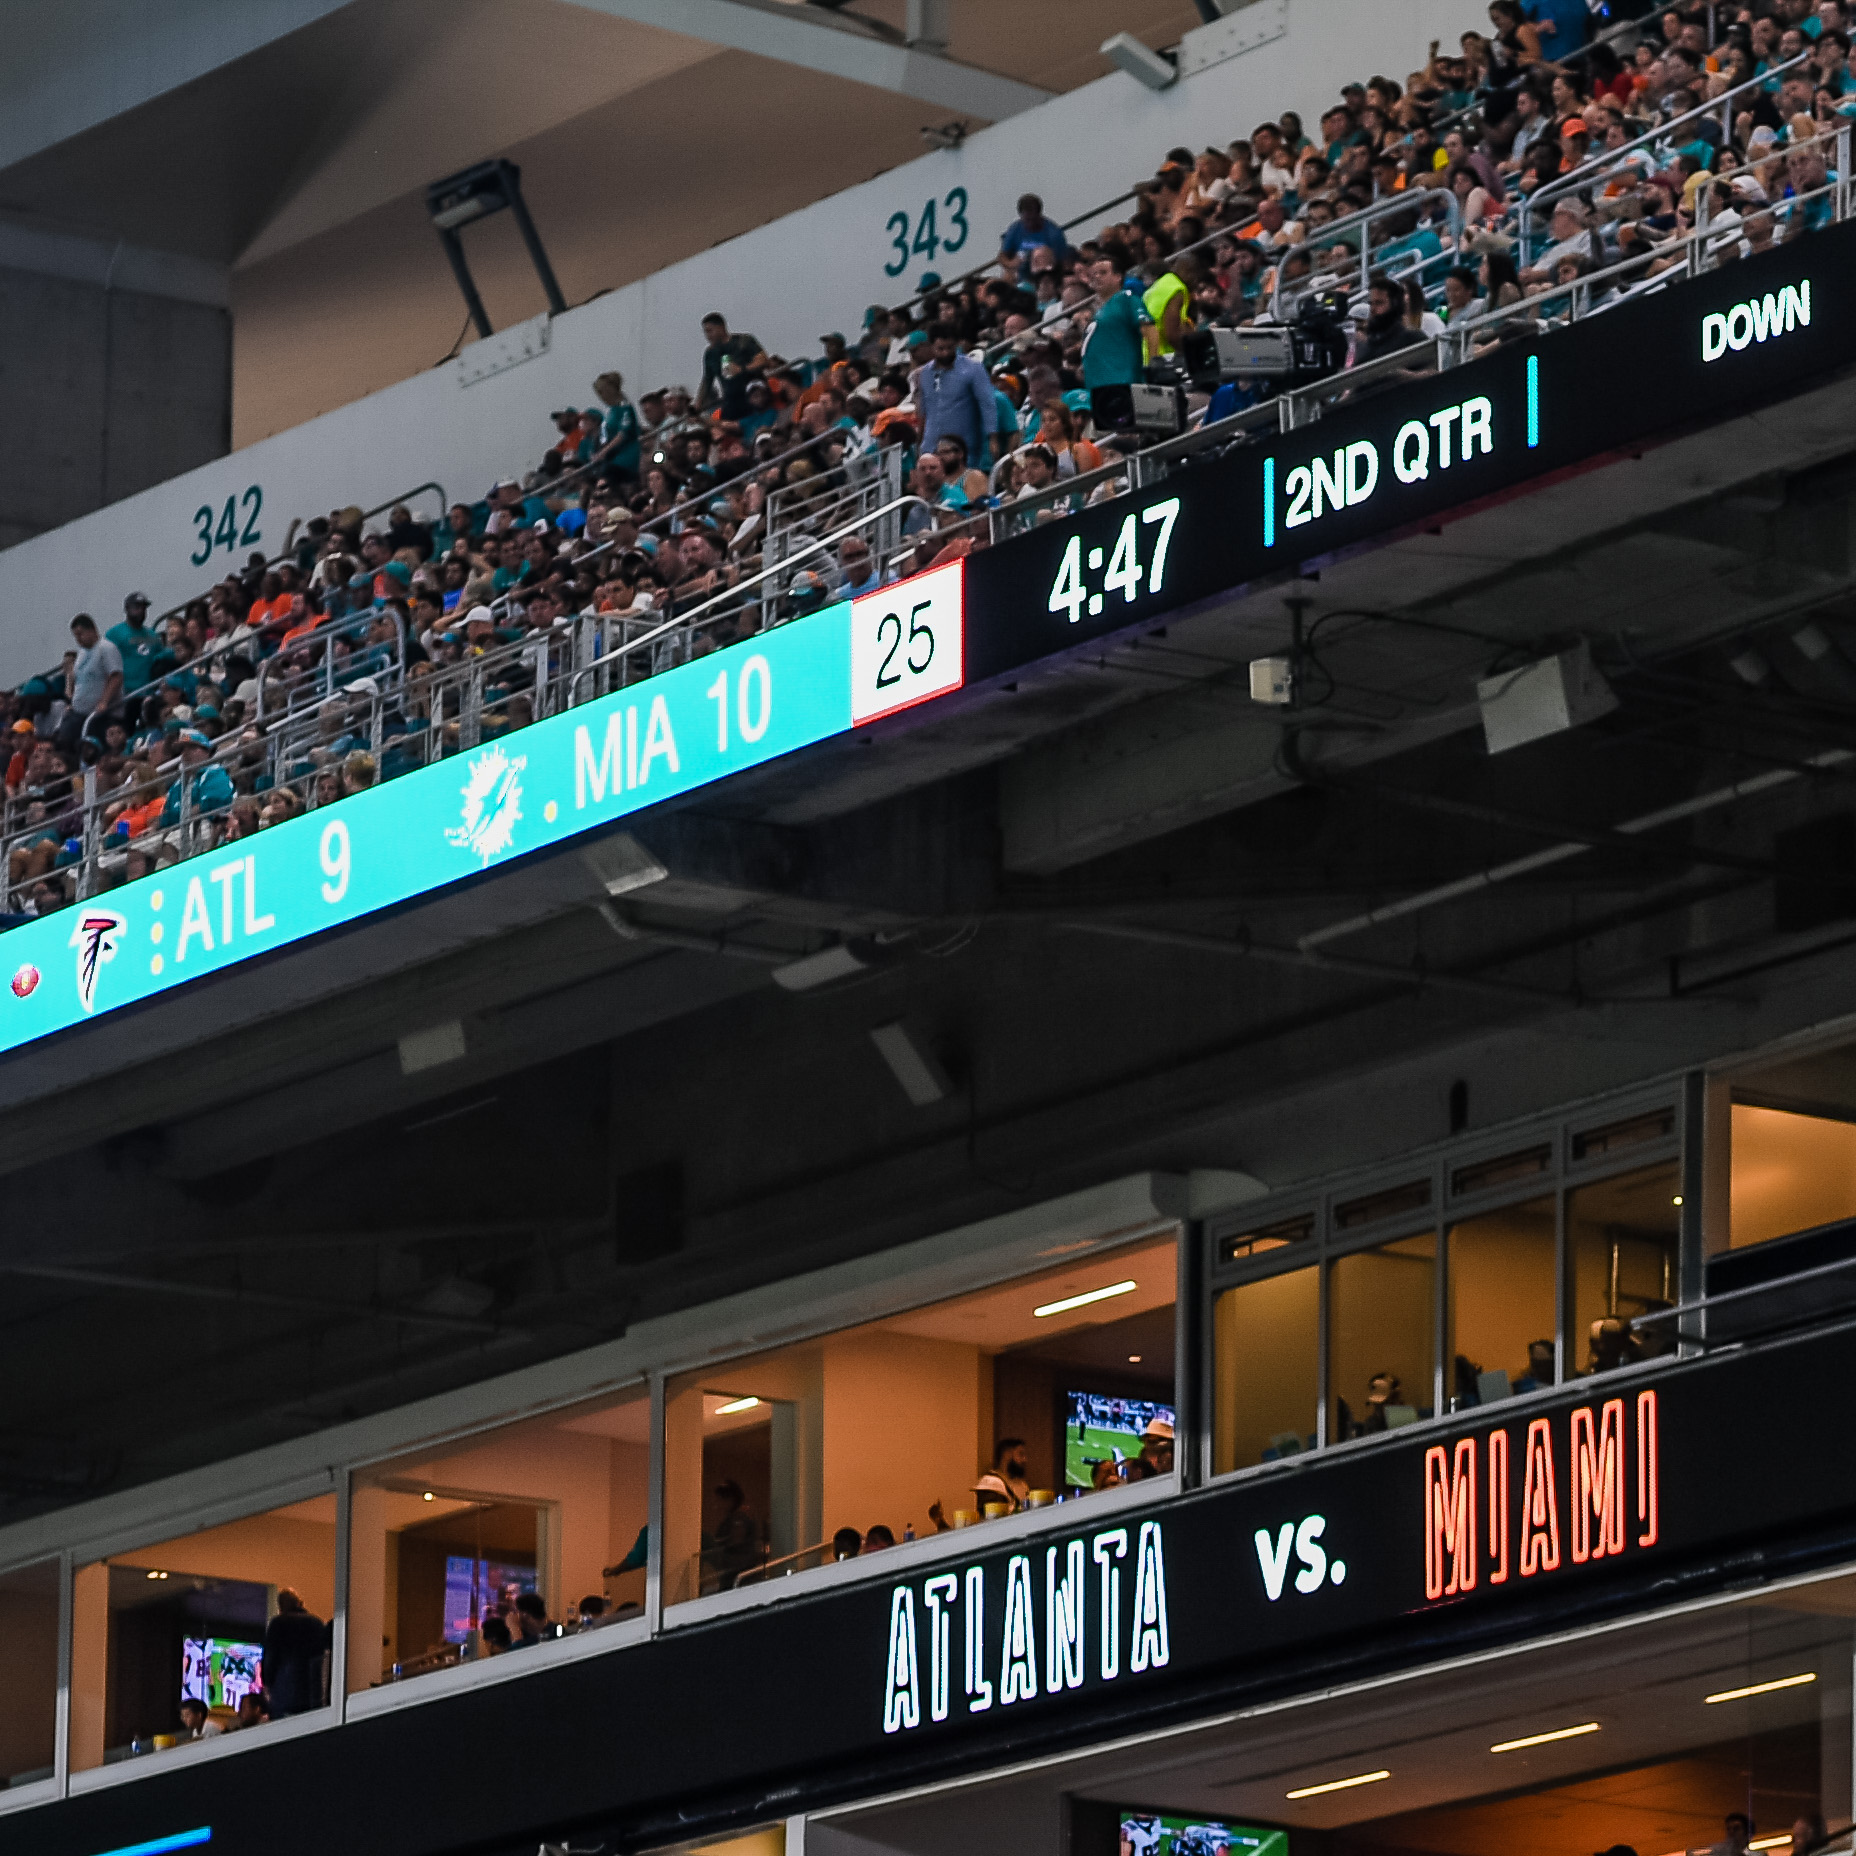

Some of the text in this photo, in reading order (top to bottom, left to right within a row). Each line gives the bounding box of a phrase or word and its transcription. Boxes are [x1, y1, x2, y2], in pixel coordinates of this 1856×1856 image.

[885, 186, 969, 277] 343
[1702, 279, 1811, 363] DOWN
[190, 484, 263, 567] 342
[1284, 396, 1494, 530] 2ND QTR
[1048, 497, 1180, 623] 4:47
[875, 600, 935, 690] 25
[574, 654, 772, 810] MIA 10
[175, 819, 351, 963] ATL 9
[882, 1520, 1170, 1734] ATLANTA
[1424, 1389, 1659, 1601] MIAMI
